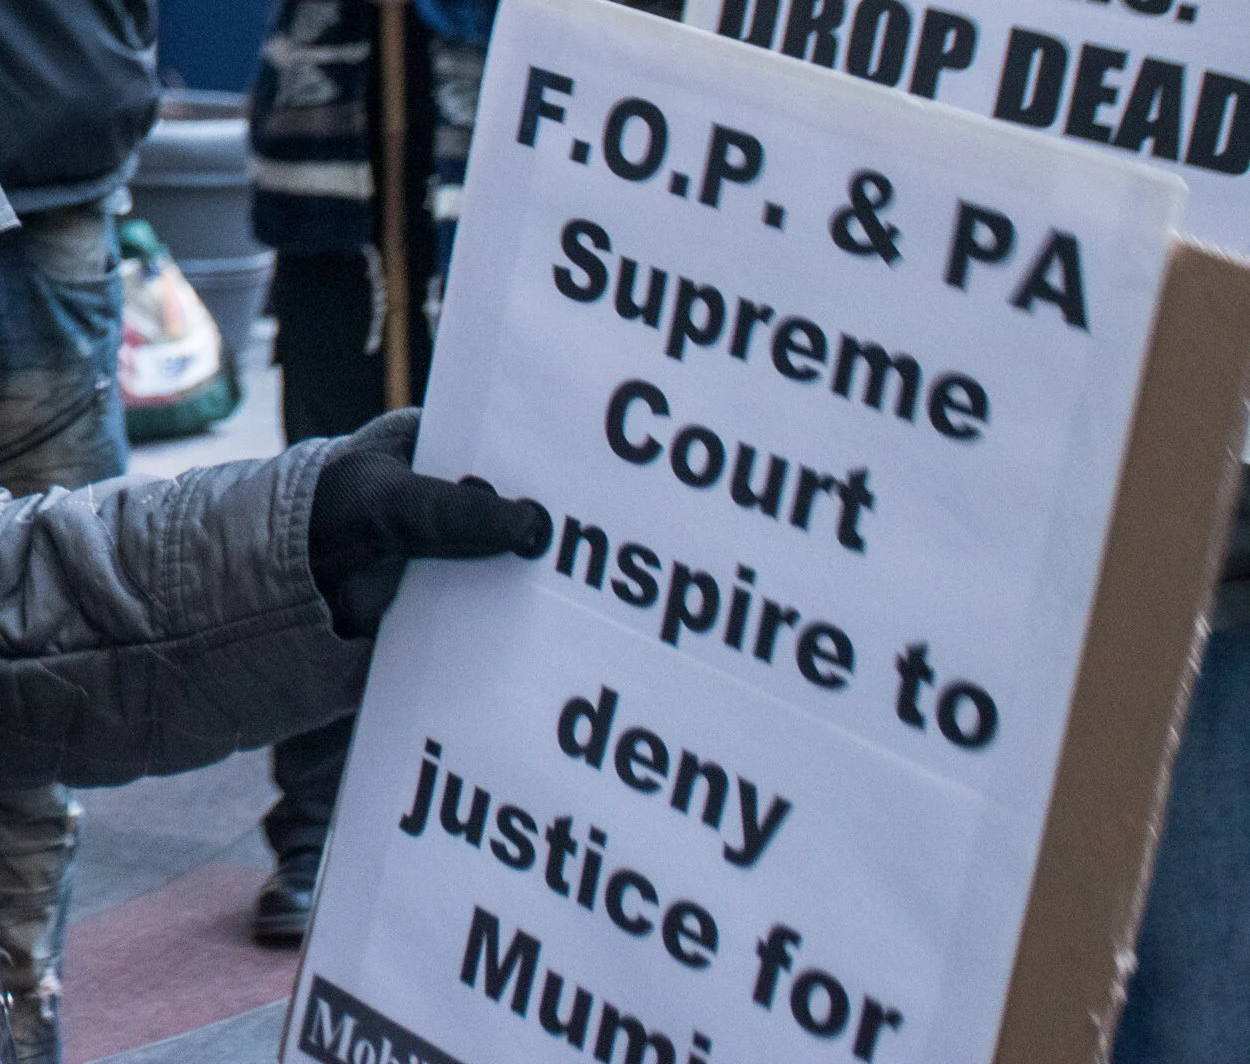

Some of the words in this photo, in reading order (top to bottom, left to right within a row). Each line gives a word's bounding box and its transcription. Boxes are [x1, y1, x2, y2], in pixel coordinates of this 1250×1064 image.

[516, 66, 786, 230] F.O.P.
[828, 168, 902, 268] &
[943, 199, 1092, 333] PA
[993, 27, 1250, 176] DEAD
[552, 218, 991, 442] Supreme
[605, 379, 876, 554] Court
[555, 514, 856, 691] nspire
[896, 642, 1000, 752] to
[557, 686, 792, 869] deny
[398, 737, 720, 969] justice
[752, 924, 904, 1063] for
